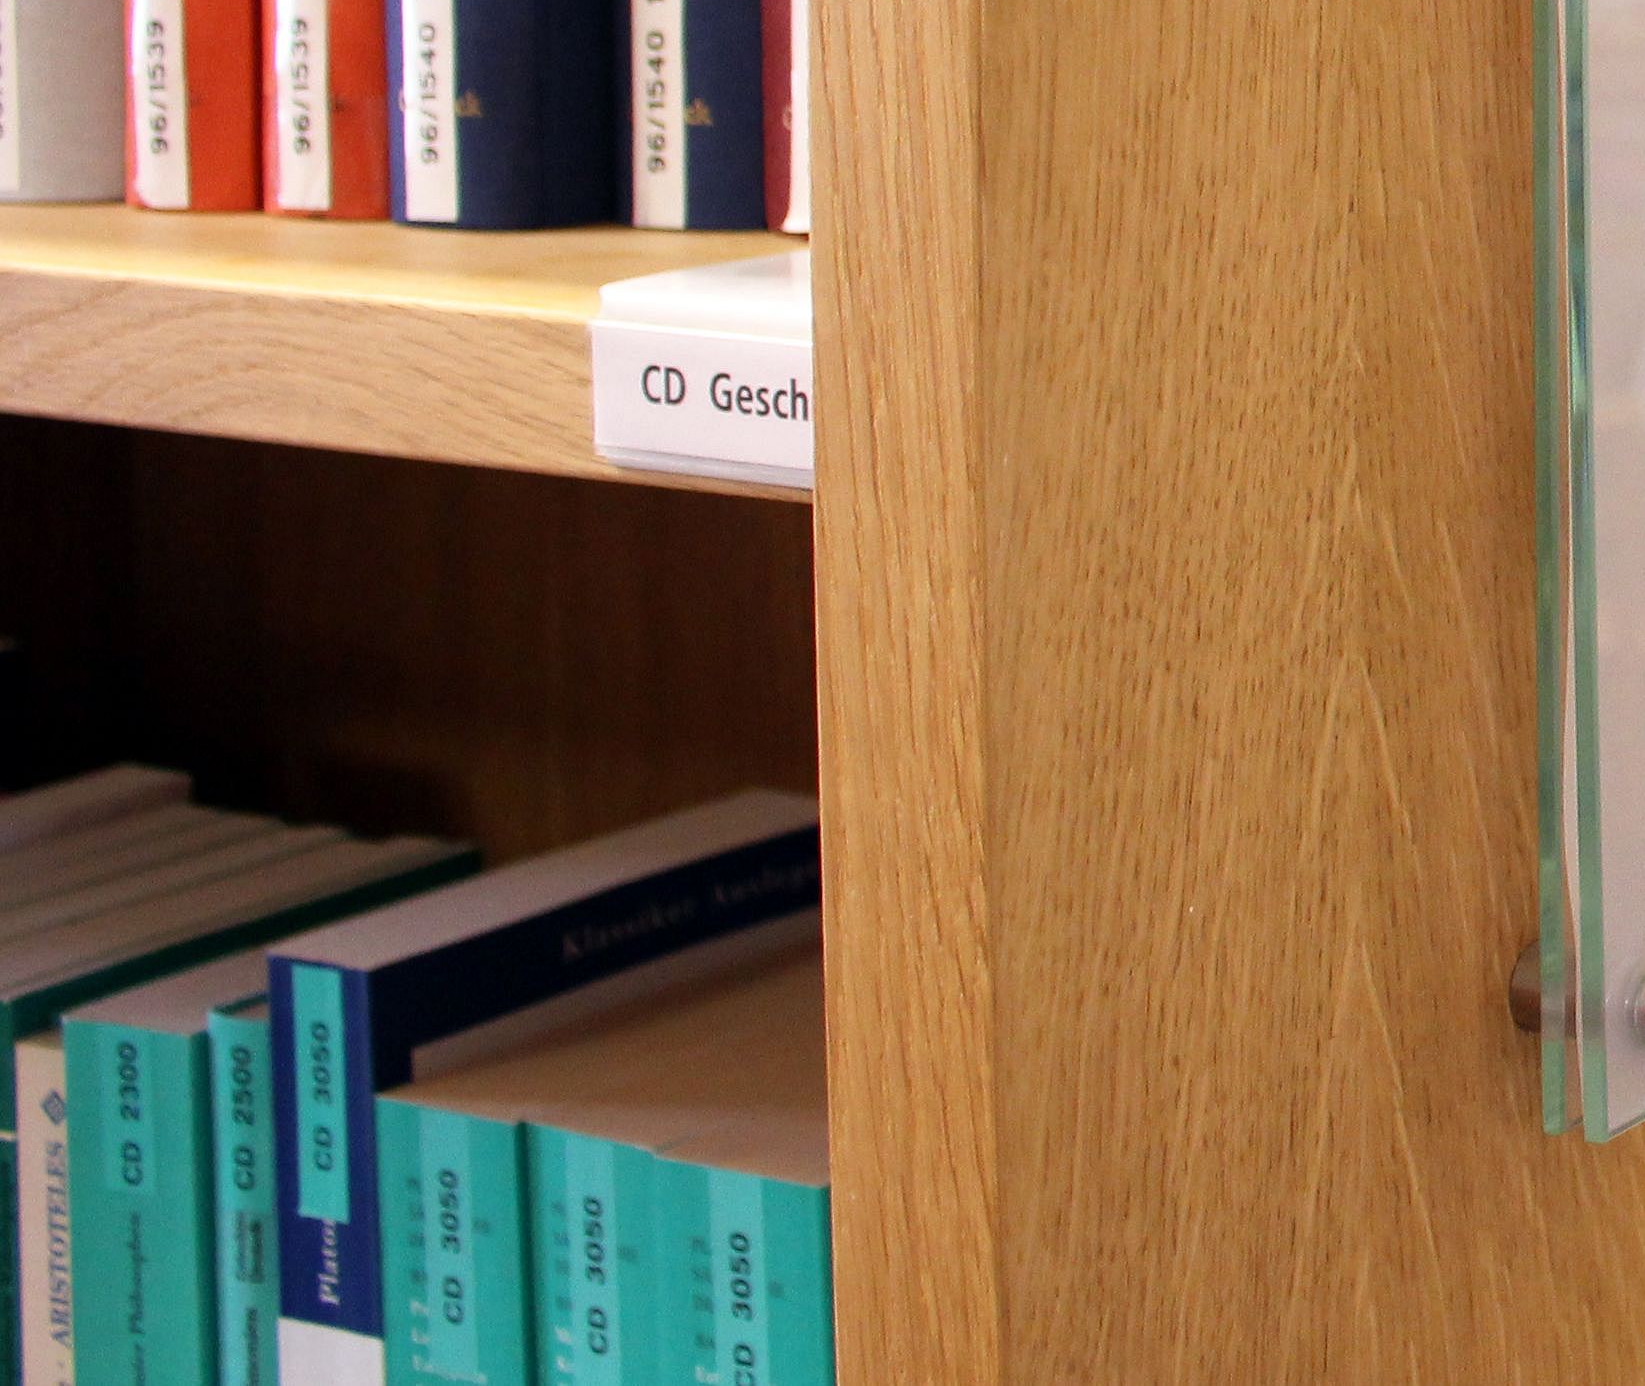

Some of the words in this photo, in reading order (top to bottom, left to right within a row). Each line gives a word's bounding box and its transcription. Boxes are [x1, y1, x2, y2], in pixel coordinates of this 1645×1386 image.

[147, 19, 168, 155] 96/1539
[290, 18, 311, 155] 96/1539
[417, 22, 438, 165] 96/1540
[646, 30, 666, 174] 96/1540
[641, 365, 686, 405] CD
[710, 372, 809, 421] Gesch
[118, 1041, 140, 1122] 2300
[232, 1045, 254, 1126] 2500
[311, 1020, 331, 1105] 3050
[121, 1140, 144, 1187] CD
[234, 1145, 256, 1192] CD
[313, 1125, 334, 1172] CD
[46, 1140, 73, 1349] ARISTOTELES
[438, 1168, 461, 1255] 3050
[584, 1195, 606, 1286] 3050
[443, 1275, 464, 1325] CD
[730, 1231, 755, 1322] 3050
[588, 1305, 609, 1356] CD
[734, 1343, 756, 1386] CD
